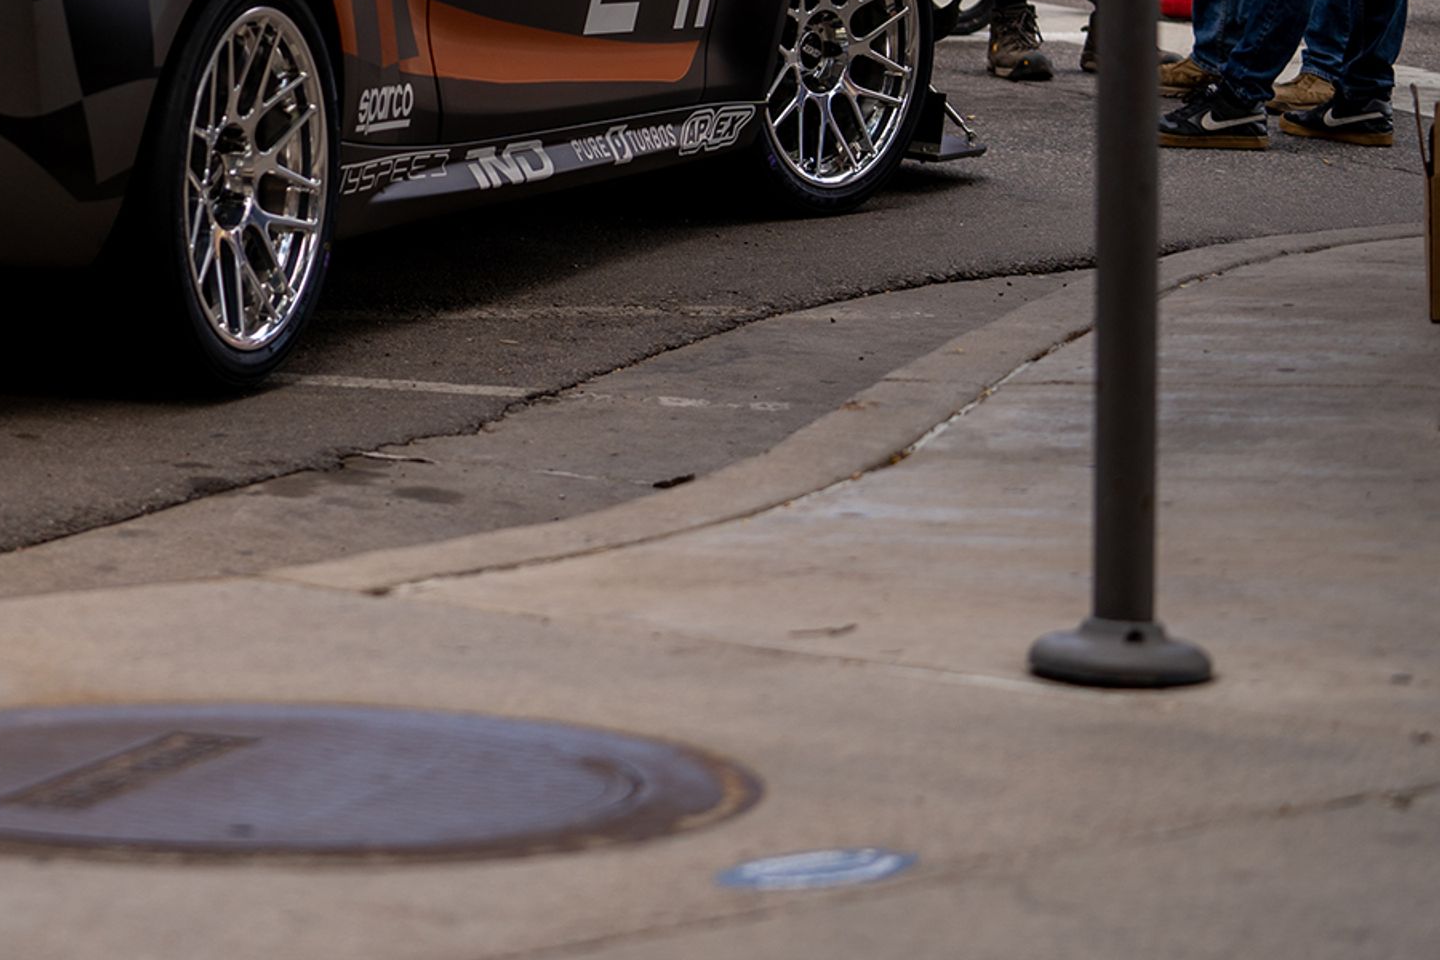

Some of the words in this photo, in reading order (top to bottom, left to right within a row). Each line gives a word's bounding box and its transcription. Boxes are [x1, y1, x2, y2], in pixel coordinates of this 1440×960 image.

[358, 82, 414, 134] sparco
[571, 135, 611, 162] PURE
[626, 124, 678, 153] TURBOS
[680, 106, 754, 155] APEX
